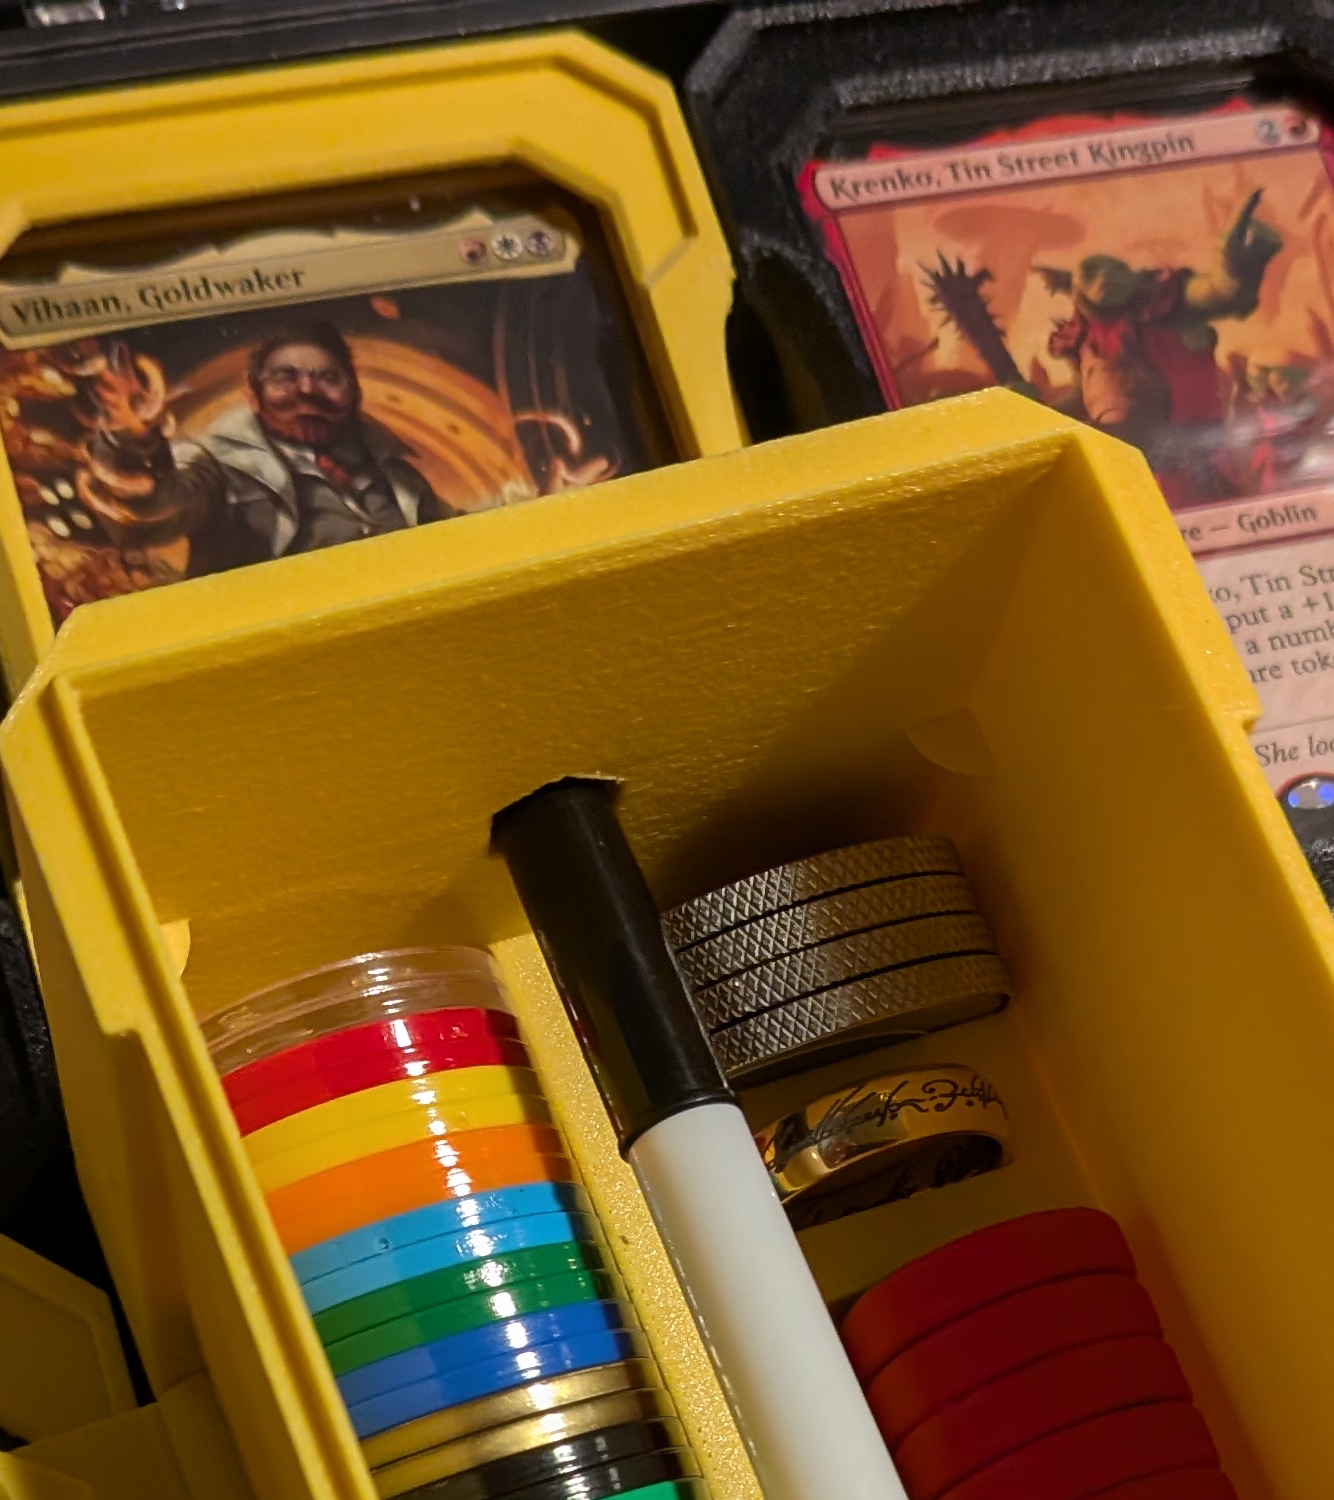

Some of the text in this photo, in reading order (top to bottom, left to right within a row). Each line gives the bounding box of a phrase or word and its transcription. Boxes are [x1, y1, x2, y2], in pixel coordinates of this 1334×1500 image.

[829, 134, 1195, 200] Krenko, Tin Street Kingpin
[12, 267, 305, 324] Vihaan, Goldwaker
[1237, 505, 1319, 534] Goblin
[1240, 573, 1291, 595] Tin
[1225, 606, 1271, 634] put
[1279, 606, 1294, 620] a
[1245, 642, 1260, 656] a
[1254, 741, 1298, 768] She
